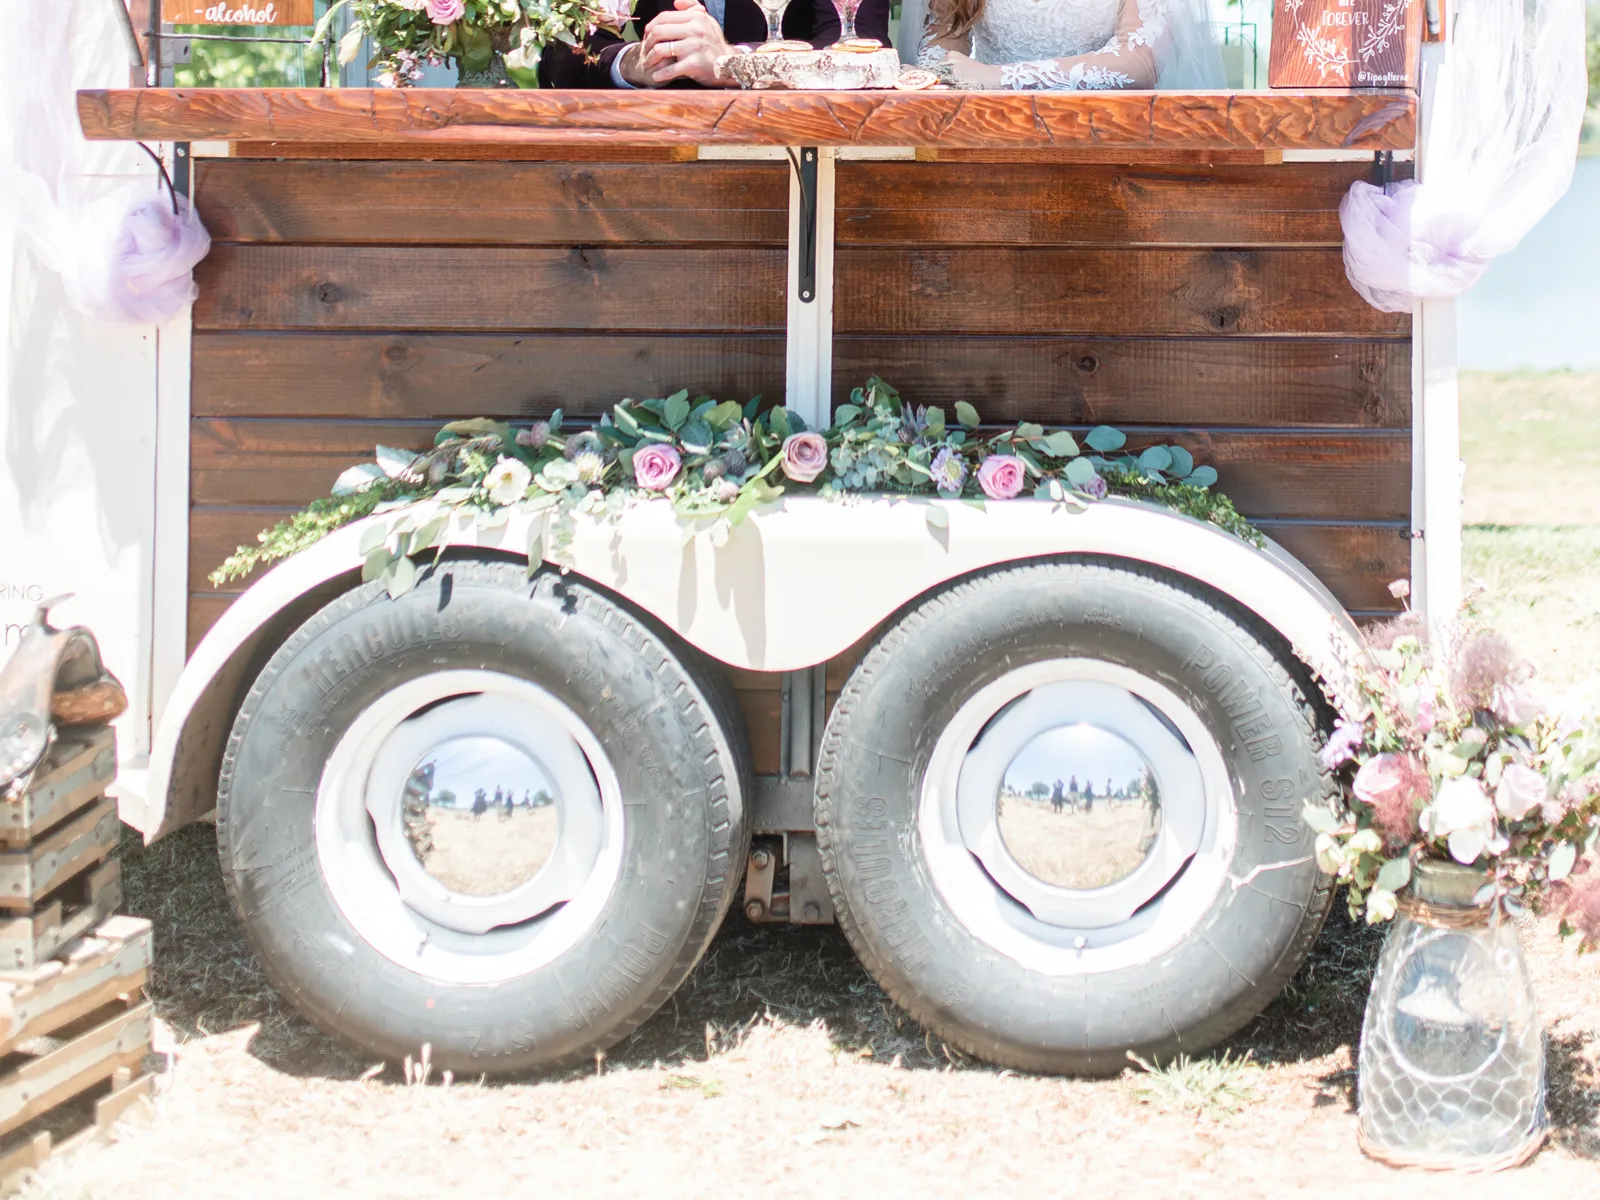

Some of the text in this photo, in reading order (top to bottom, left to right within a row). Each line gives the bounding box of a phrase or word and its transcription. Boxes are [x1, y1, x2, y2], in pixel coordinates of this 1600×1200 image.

[1322, 11, 1370, 27] FOREVER
[302, 607, 463, 699] HERCULES
[1180, 644, 1301, 845] POWER ST2
[852, 796, 937, 972] HERCULES
[556, 920, 669, 1029] POWER
